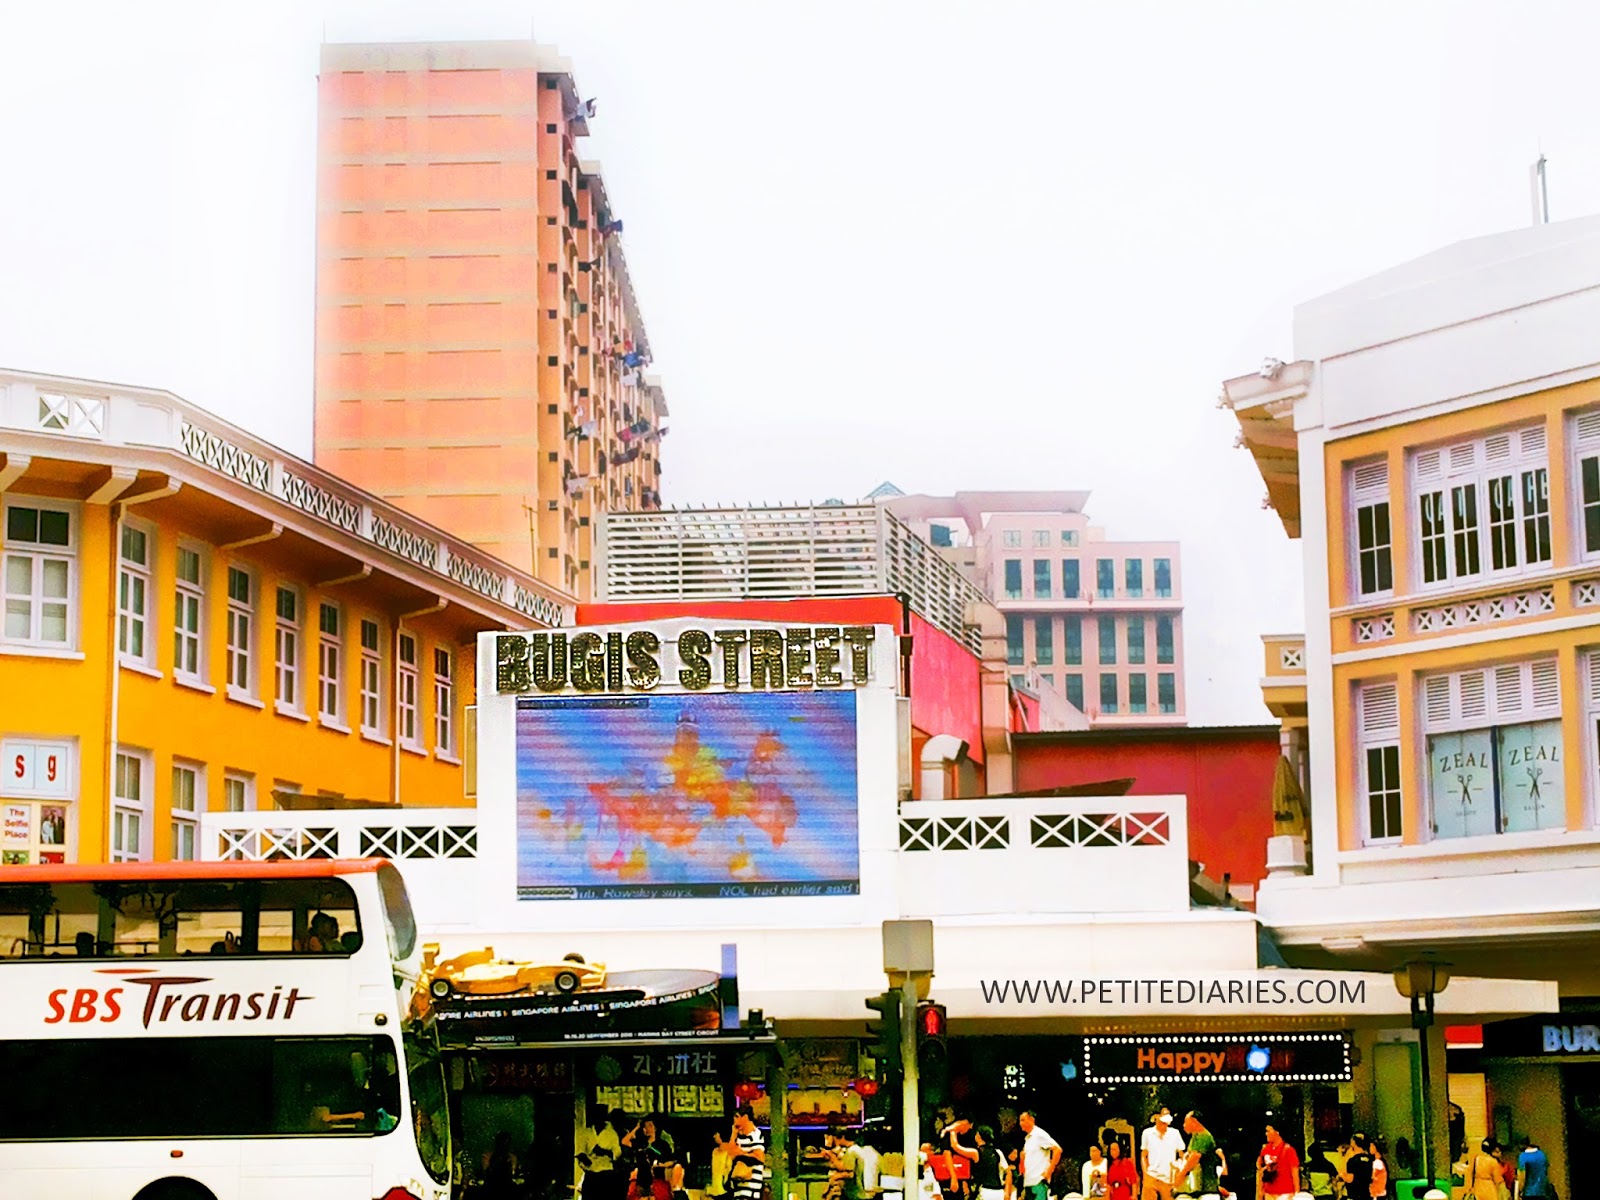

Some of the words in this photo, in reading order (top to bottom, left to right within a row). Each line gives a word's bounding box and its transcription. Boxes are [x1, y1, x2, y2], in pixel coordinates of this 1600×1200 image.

[496, 630, 660, 693] BUGIS
[677, 626, 876, 690] STREET
[1440, 752, 1488, 773] ZEAL
[1508, 745, 1560, 766] ZEAL
[9, 808, 25, 816] The
[4, 830, 28, 838] Place
[719, 886, 748, 896] NOL
[44, 987, 124, 1025] SBS
[121, 976, 316, 1030] Transit
[512, 1006, 559, 1016] SINGAPORE
[561, 1003, 599, 1014] AIRLINES
[608, 997, 657, 1010] SINGAPORE
[658, 991, 692, 1004] AIRLINES
[1137, 1047, 1226, 1074] Happy
